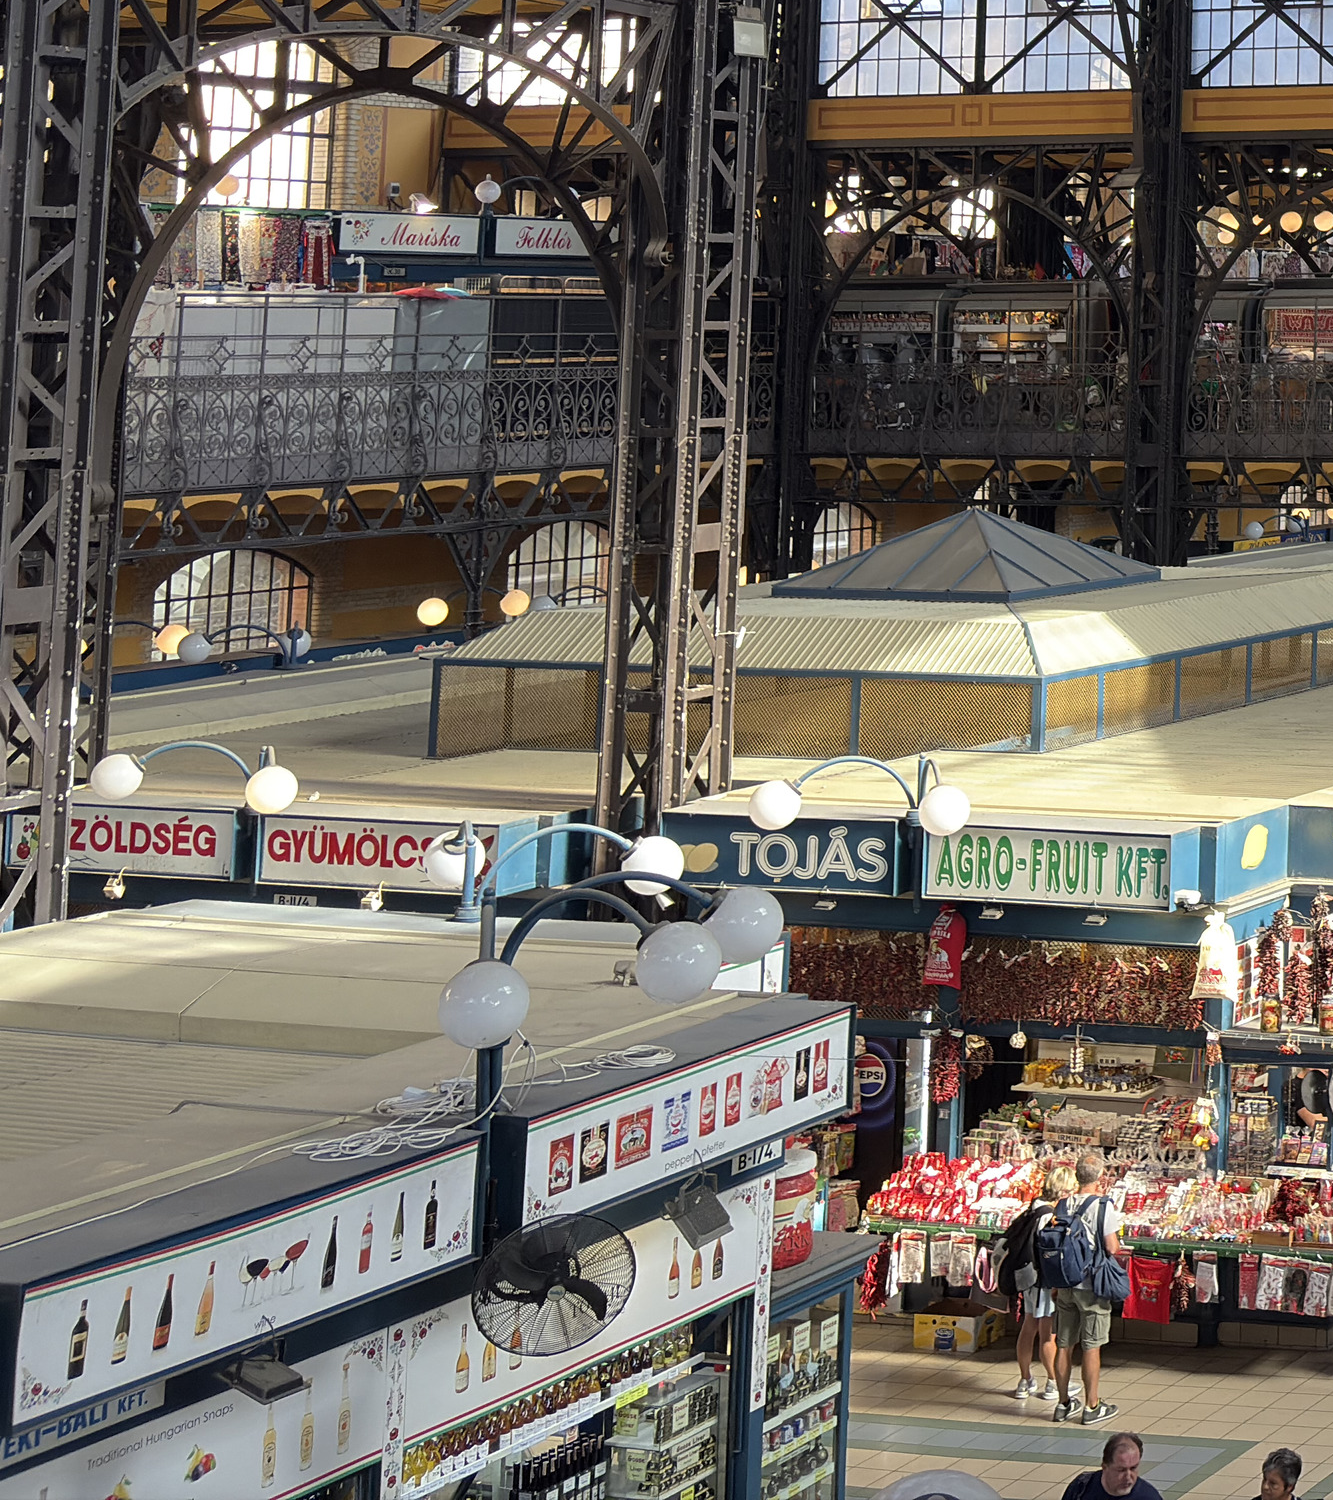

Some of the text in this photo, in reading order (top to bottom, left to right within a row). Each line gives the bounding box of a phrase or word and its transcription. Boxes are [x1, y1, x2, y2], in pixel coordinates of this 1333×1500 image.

[380, 222, 462, 247] Mariska
[515, 225, 572, 250] Folklór
[69, 814, 217, 858] ZÖLDSÉG
[730, 827, 889, 883] TOJÁS
[935, 833, 1169, 900] AGRO-FRUIT KFT.
[858, 1069, 884, 1081] EPSI
[117, 1389, 149, 1416] KFT.
[87, 1404, 235, 1471] Traditional Hungarian Snaps
